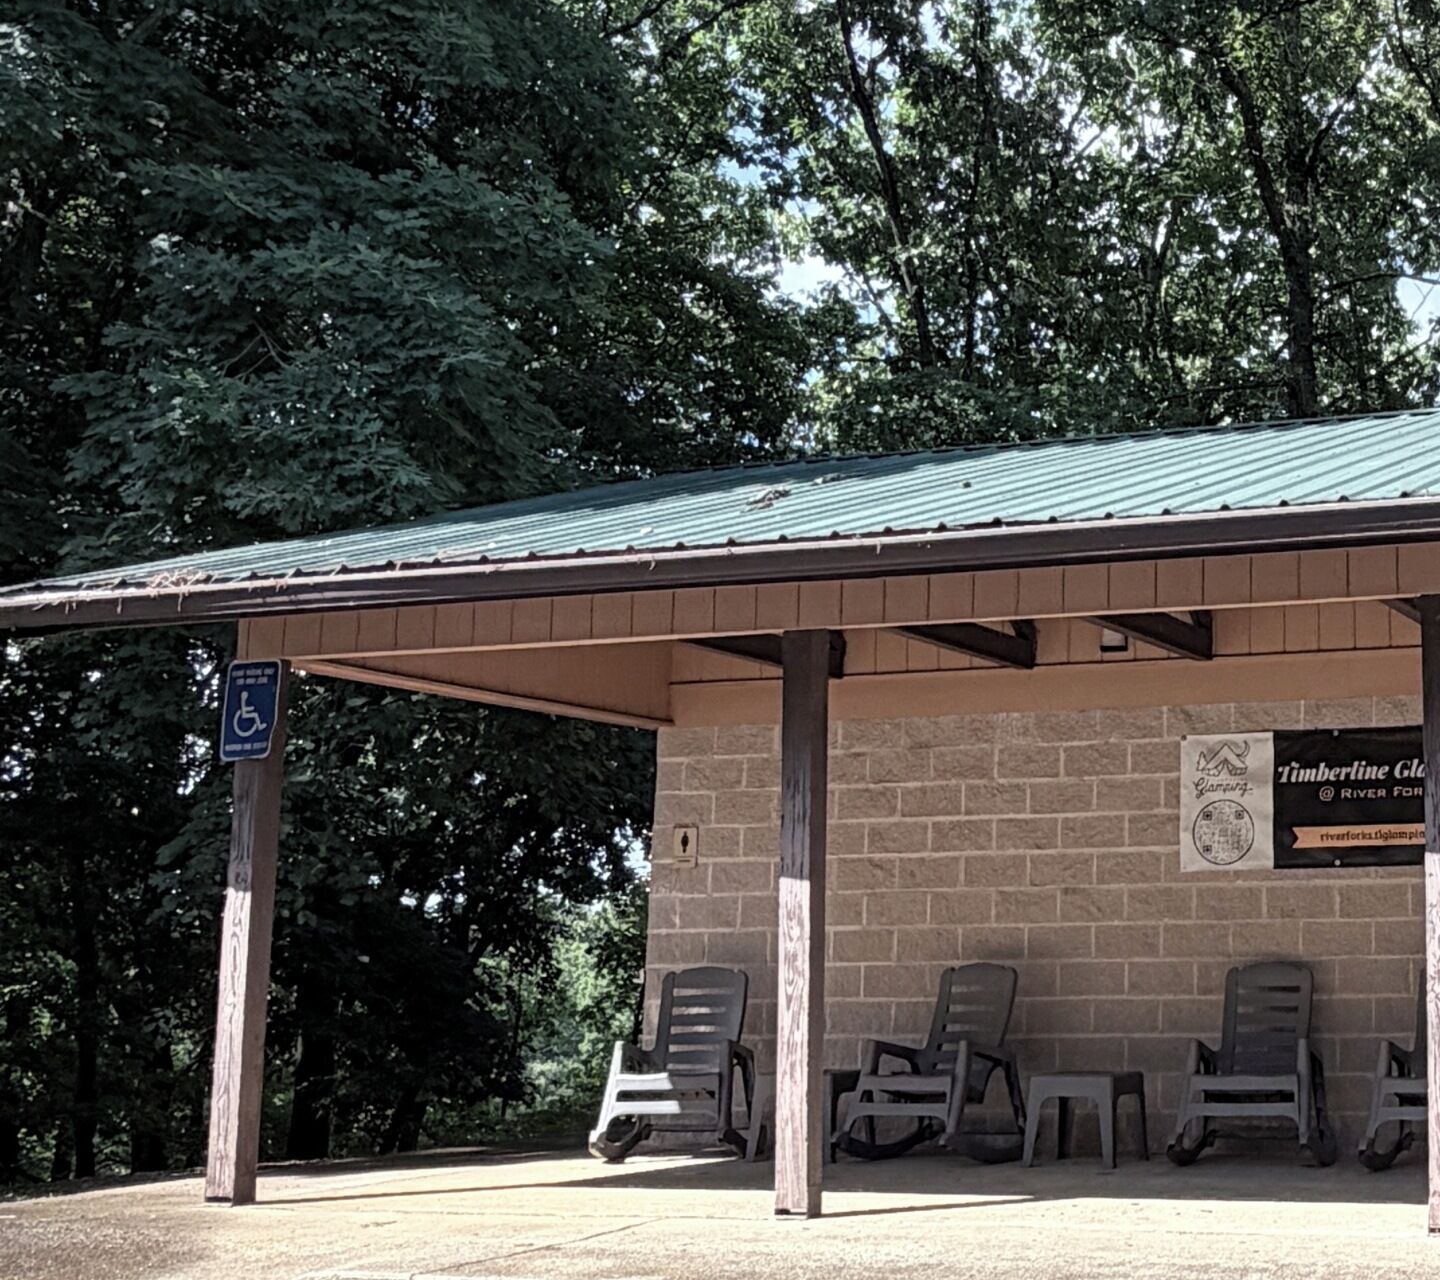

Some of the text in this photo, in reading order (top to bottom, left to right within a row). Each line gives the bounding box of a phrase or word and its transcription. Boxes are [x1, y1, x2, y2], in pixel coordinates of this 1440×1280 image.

[1278, 759, 1390, 783] Timberline
[1192, 777, 1253, 799] Glamping
[1319, 785, 1424, 802] @ RIVER FOR
